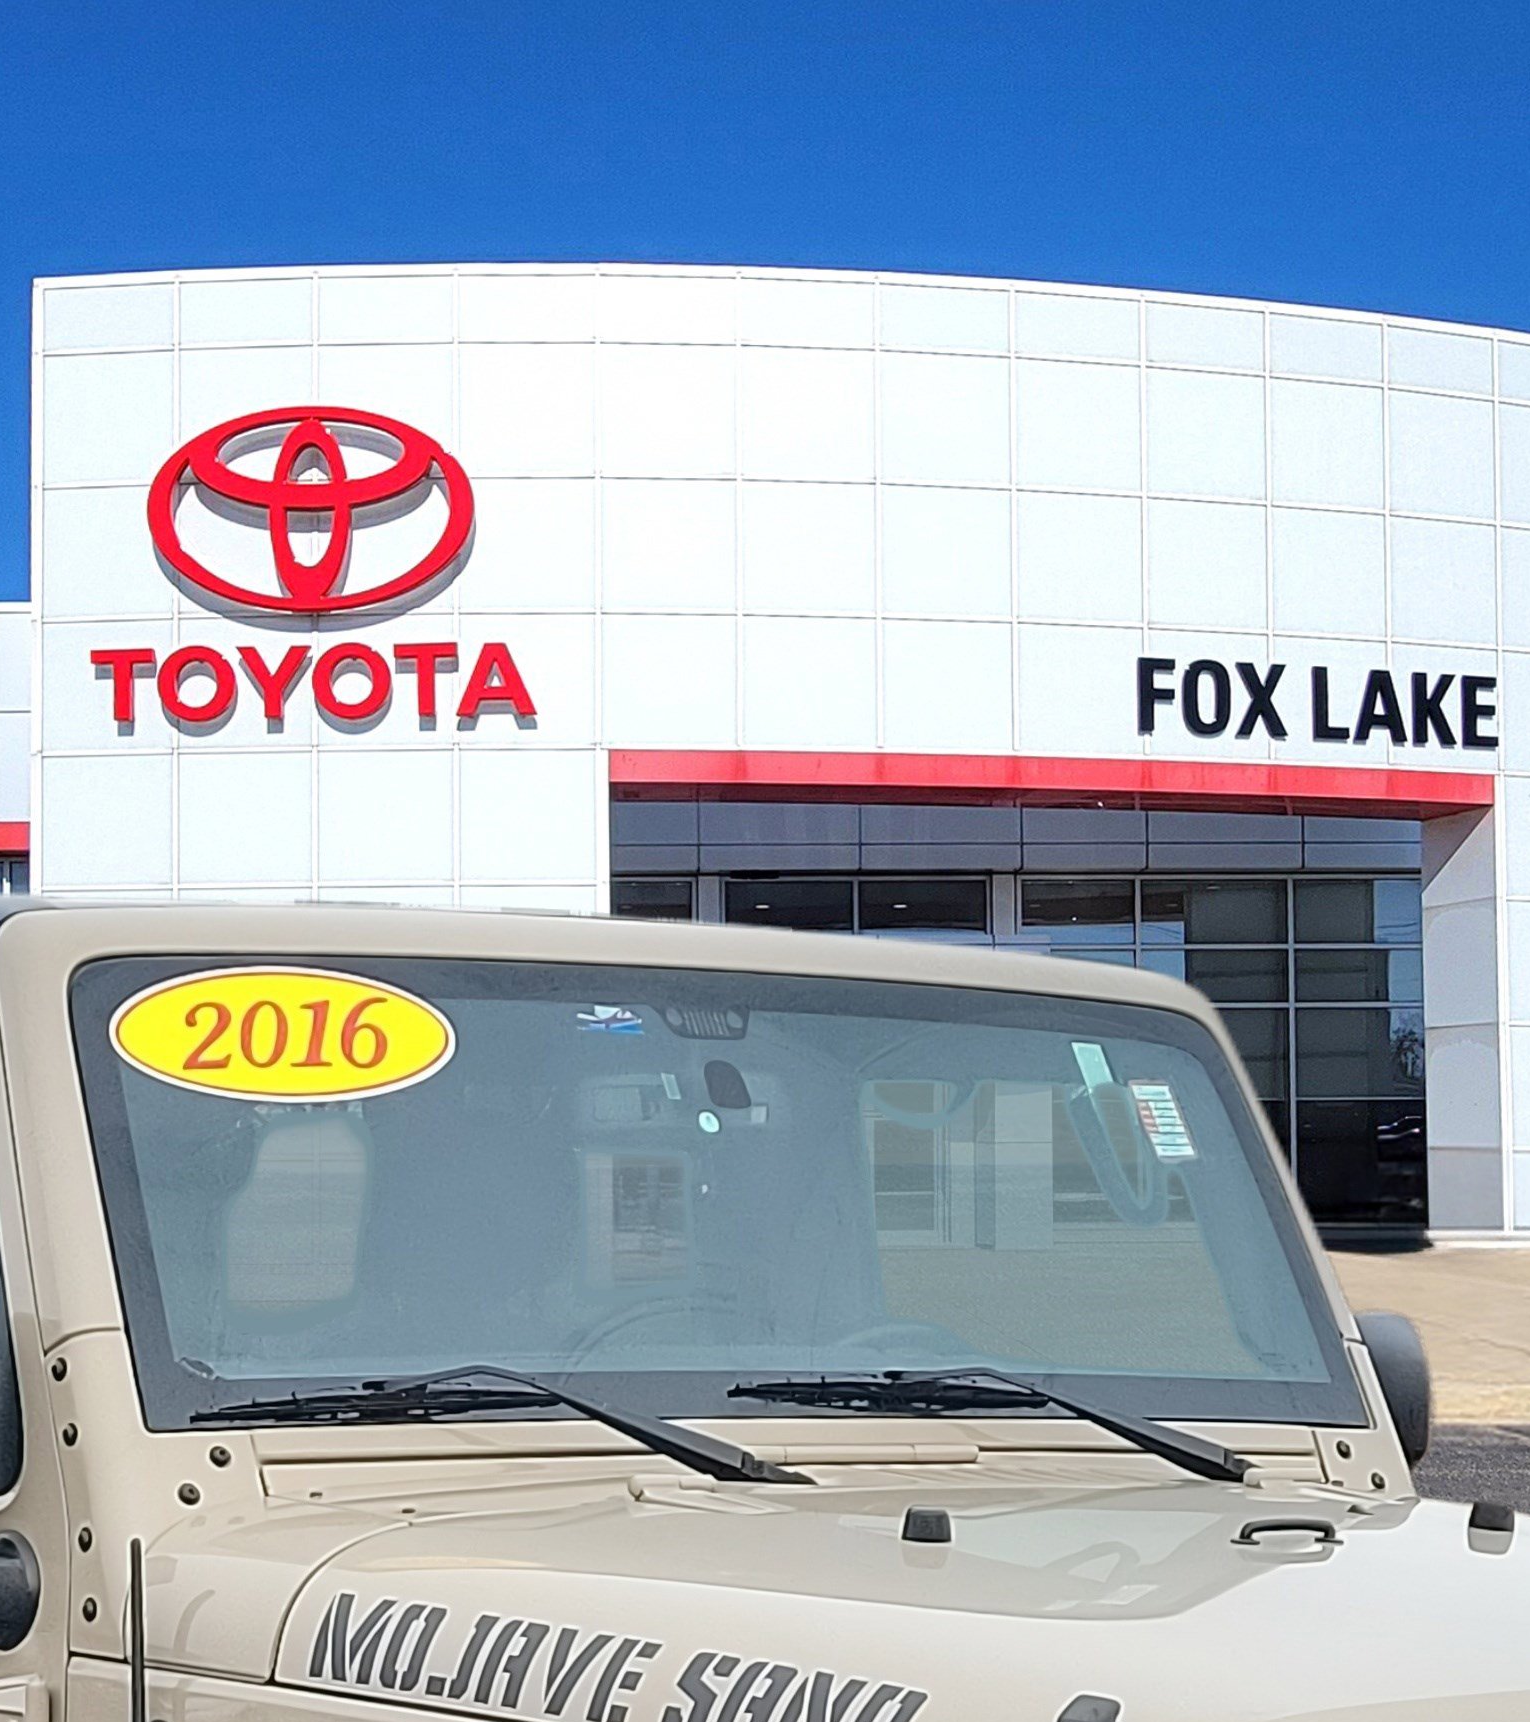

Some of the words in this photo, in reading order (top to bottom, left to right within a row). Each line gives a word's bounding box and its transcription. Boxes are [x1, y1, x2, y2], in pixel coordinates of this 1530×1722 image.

[90, 641, 538, 732] TOYOTA
[1137, 657, 1288, 739] FOX
[1311, 665, 1499, 749] LAKE
[182, 997, 389, 1071] 2016
